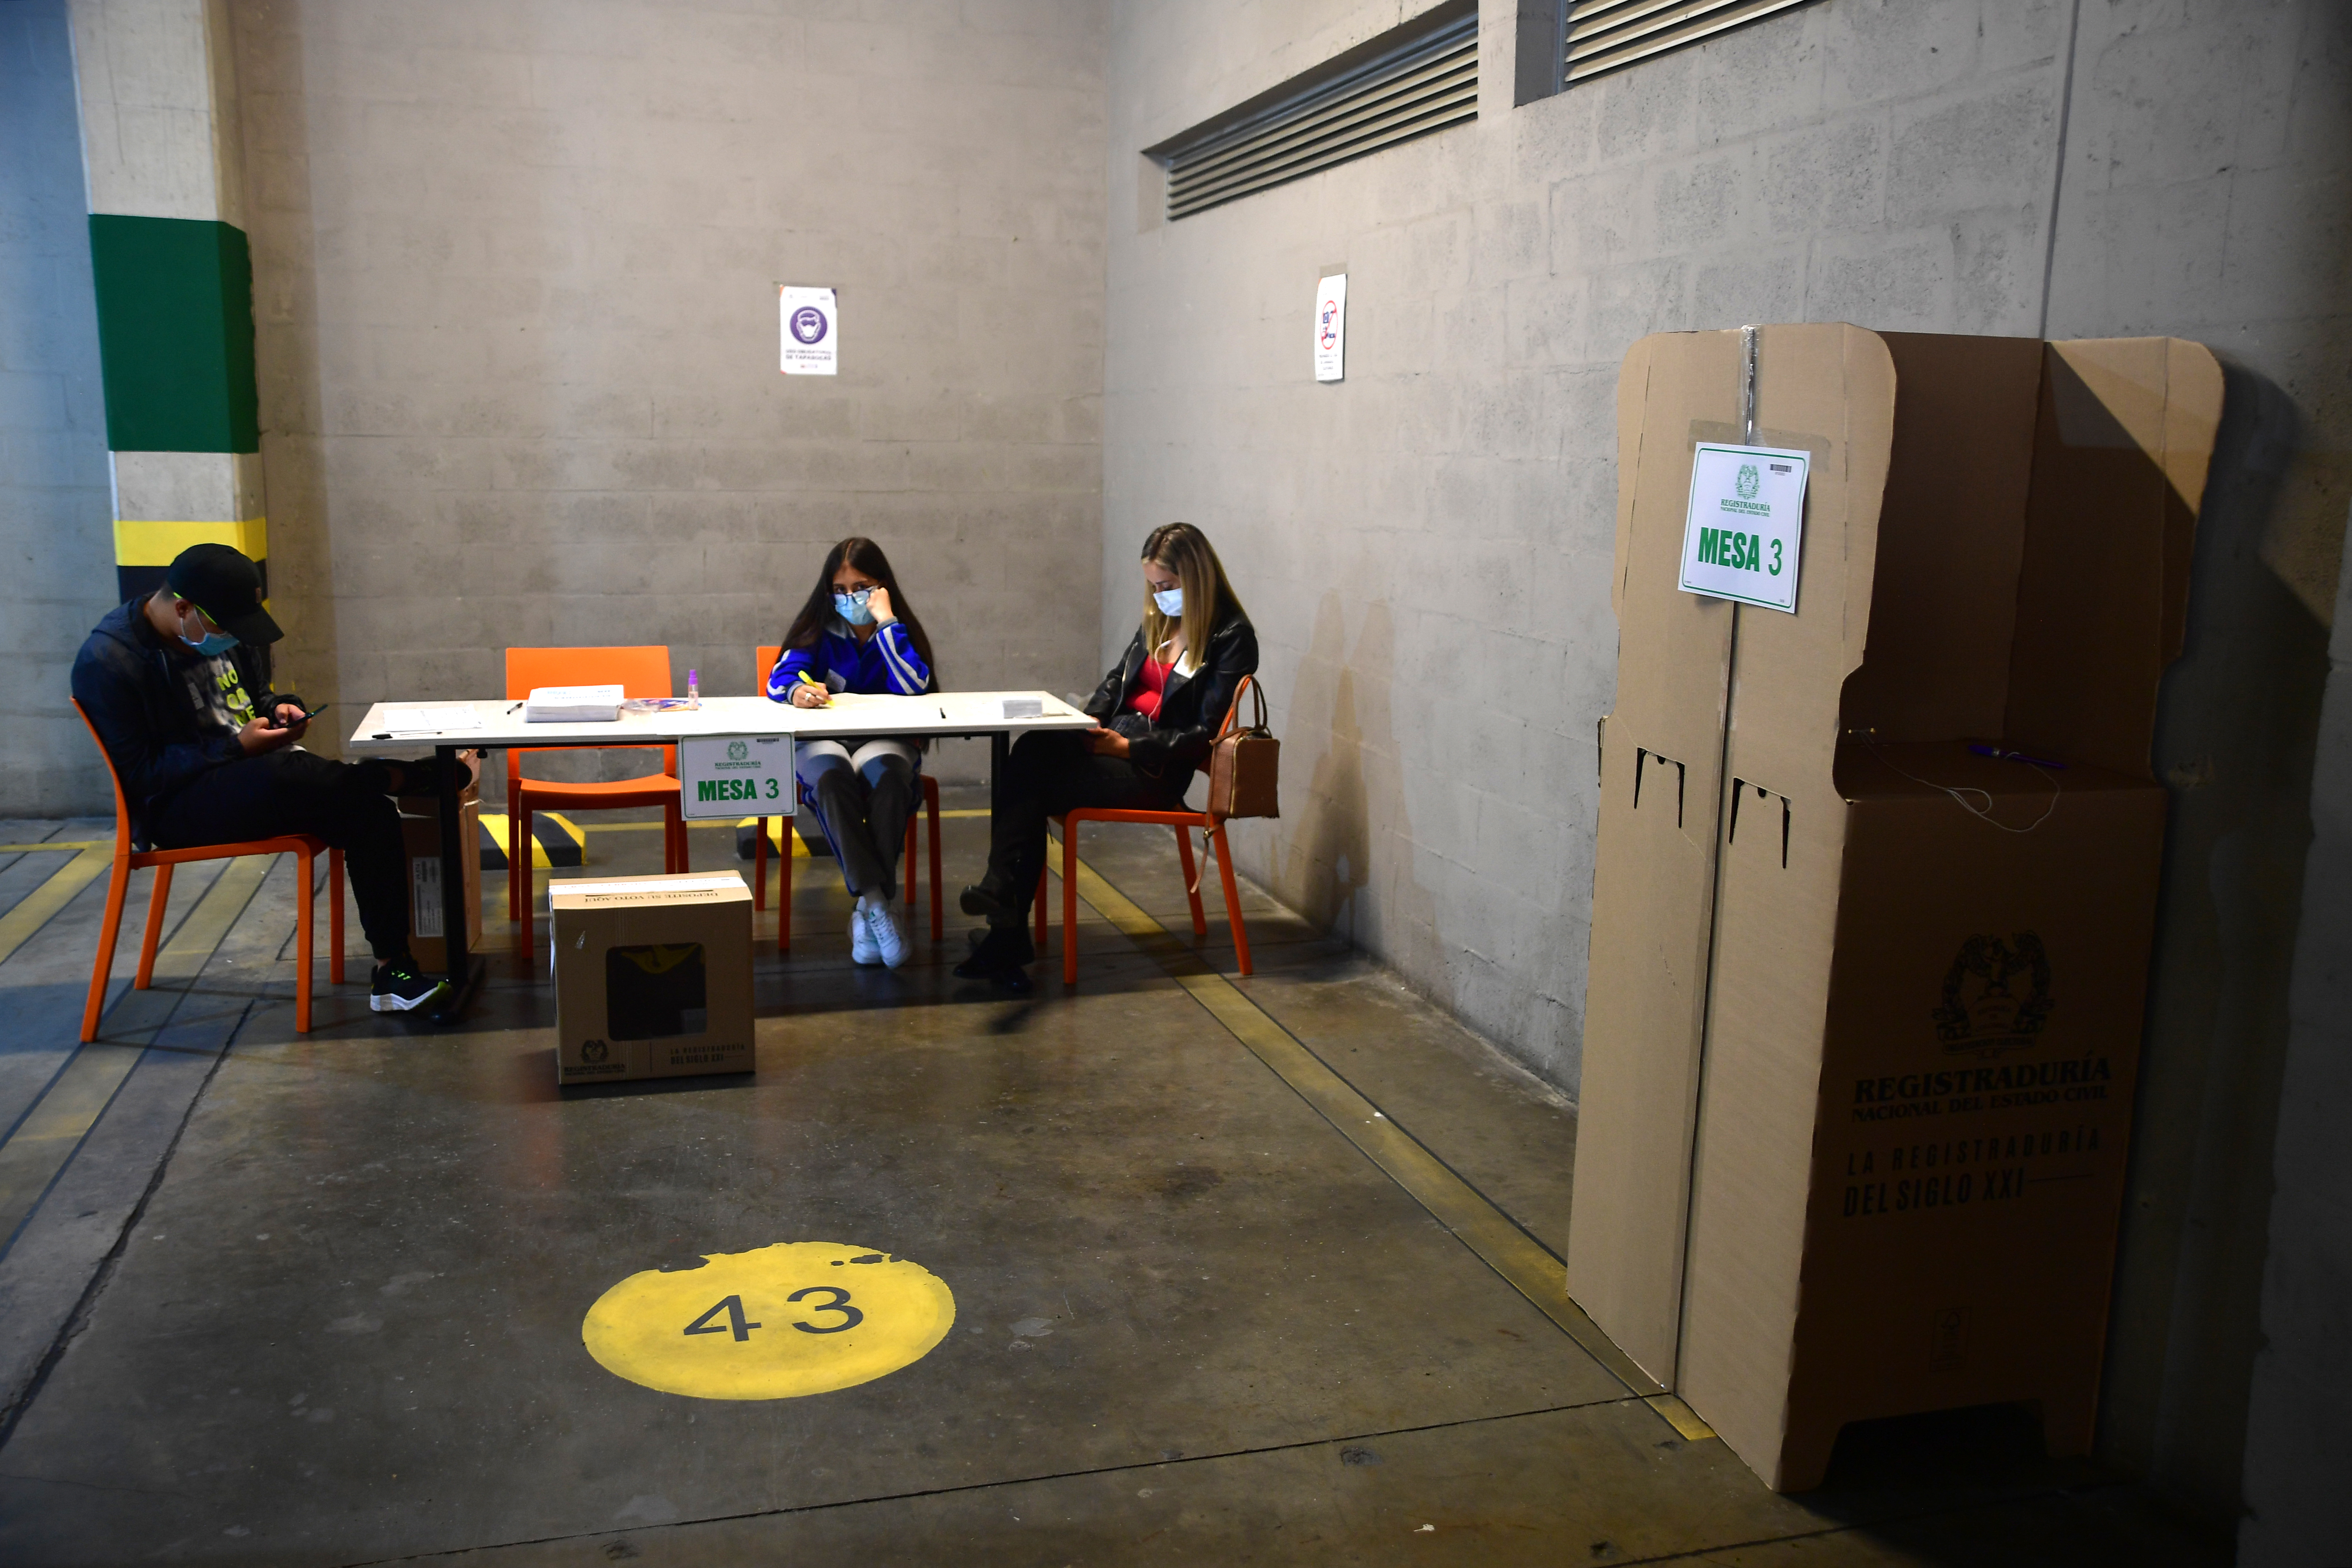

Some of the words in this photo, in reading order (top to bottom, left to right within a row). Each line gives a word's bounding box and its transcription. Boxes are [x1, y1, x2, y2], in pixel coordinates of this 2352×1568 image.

[1721, 499, 1770, 511] REGISTRADURÍA
[1698, 527, 1760, 572] MESA
[1768, 539, 1782, 576] 3
[698, 778, 757, 801] MESA
[765, 778, 779, 799] 3
[671, 1056, 684, 1064] DEL
[686, 1054, 708, 1063] SIGLO
[711, 1054, 724, 1062] XXI
[1854, 1050, 2111, 1104] REGISTRADURÍA
[1851, 1100, 1941, 1122] NACIONAL
[1949, 1096, 1983, 1113] DEL
[1990, 1089, 2059, 1109] ESTADO
[2064, 1085, 2109, 1102] CIVIL
[1847, 1150, 1874, 1177] LA
[1892, 1124, 2100, 1171] REGISTRADURÍA
[1843, 1181, 1888, 1217] DEL
[1895, 1173, 1973, 1212] SIGLO
[1982, 1167, 2025, 1201] XXI
[683, 1286, 864, 1342] 43
